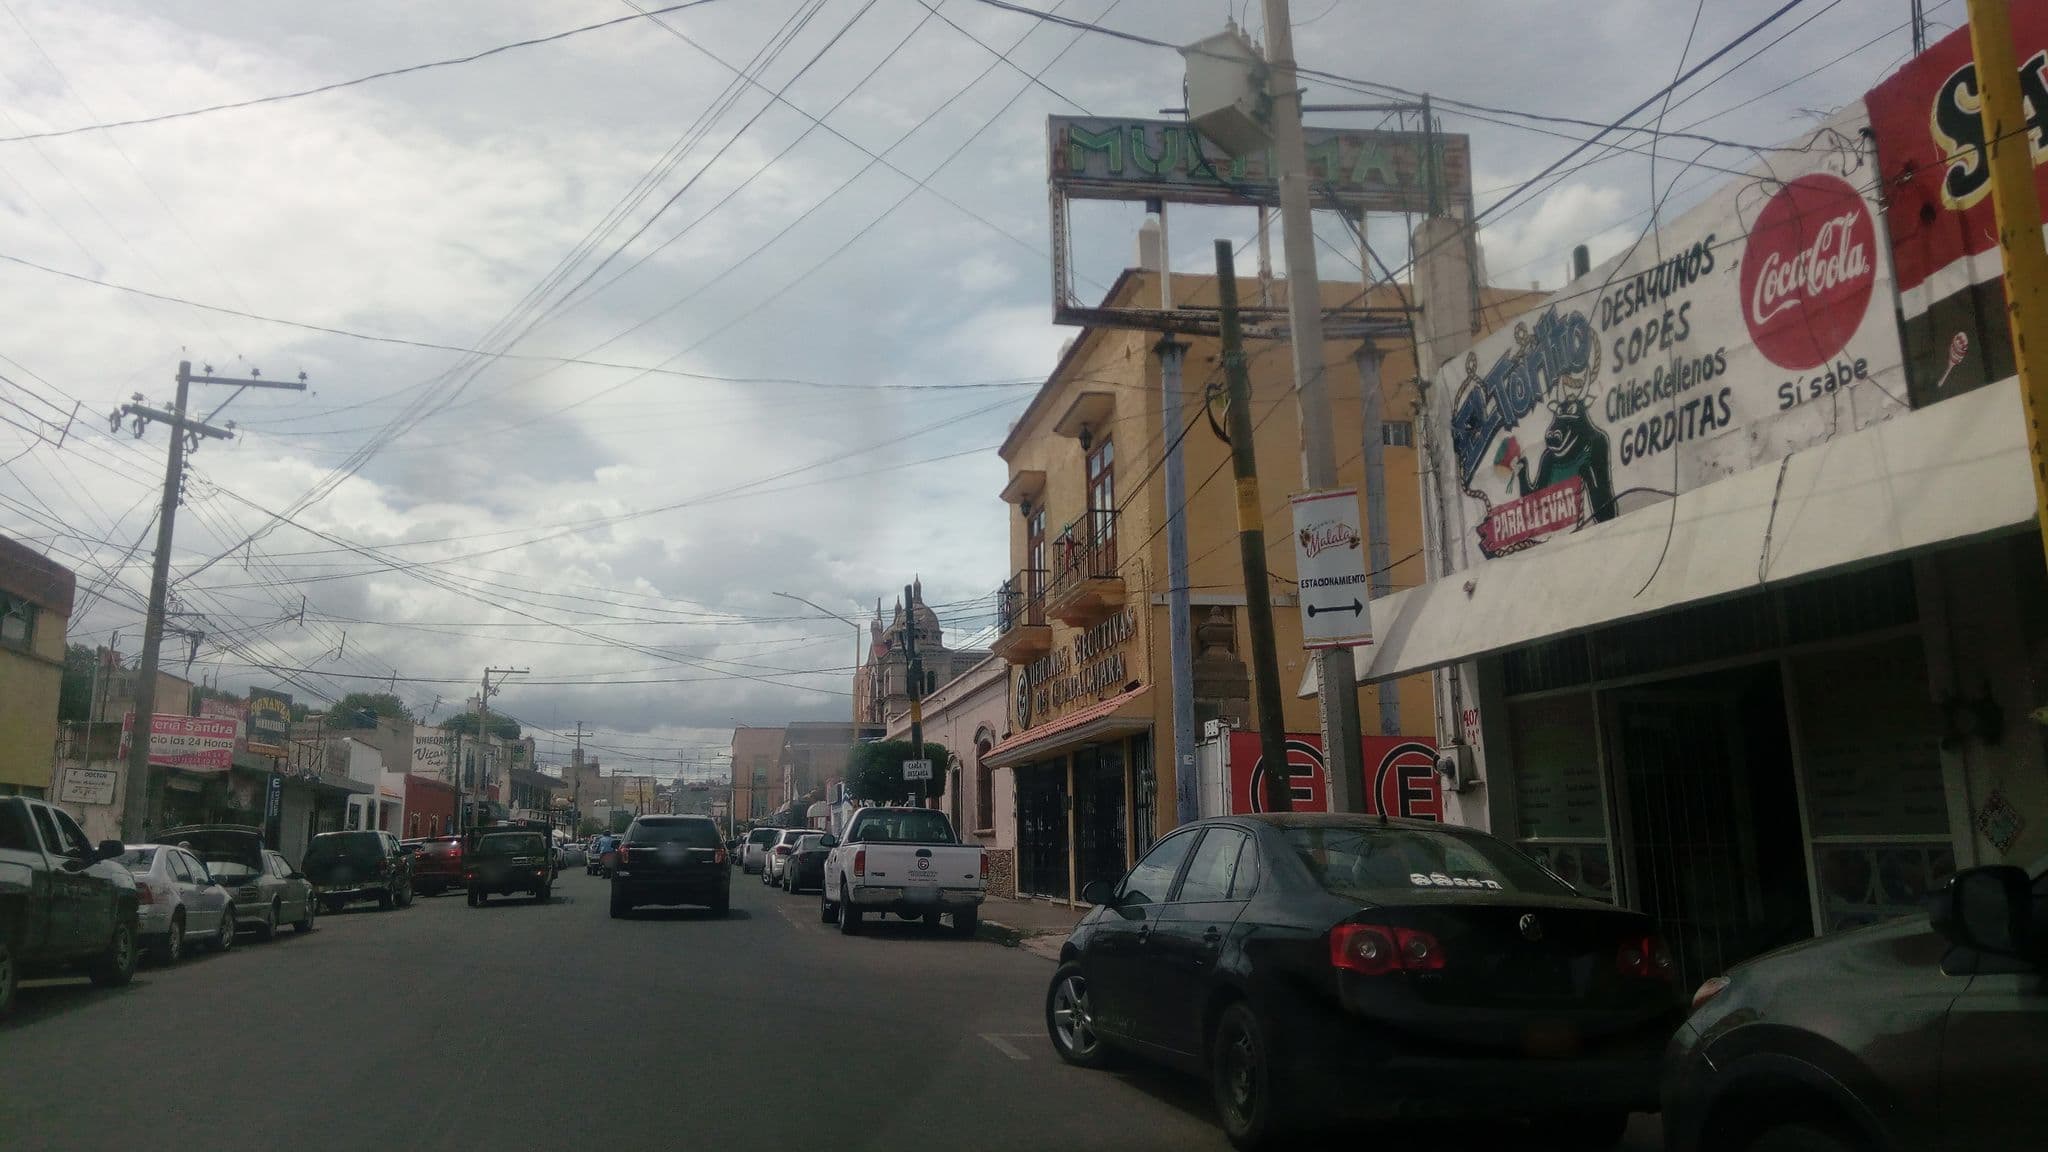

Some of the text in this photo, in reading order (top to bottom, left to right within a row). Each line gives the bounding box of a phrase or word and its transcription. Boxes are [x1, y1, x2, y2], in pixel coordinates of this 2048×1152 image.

[1601, 233, 1716, 332] DESAYUNOS
[1613, 301, 1691, 374] SOPES
[1606, 347, 1727, 423] Chiles Rellenos
[1777, 358, 1868, 411] Sí sabe
[1620, 387, 1732, 466] GORDITAS
[1493, 486, 1577, 542] PARA LLEVAR
[1300, 574, 1366, 589] ESTACIONAMIENTO
[185, 719, 234, 734] Sandra
[189, 737, 201, 746] 24
[204, 738, 233, 749] Horas
